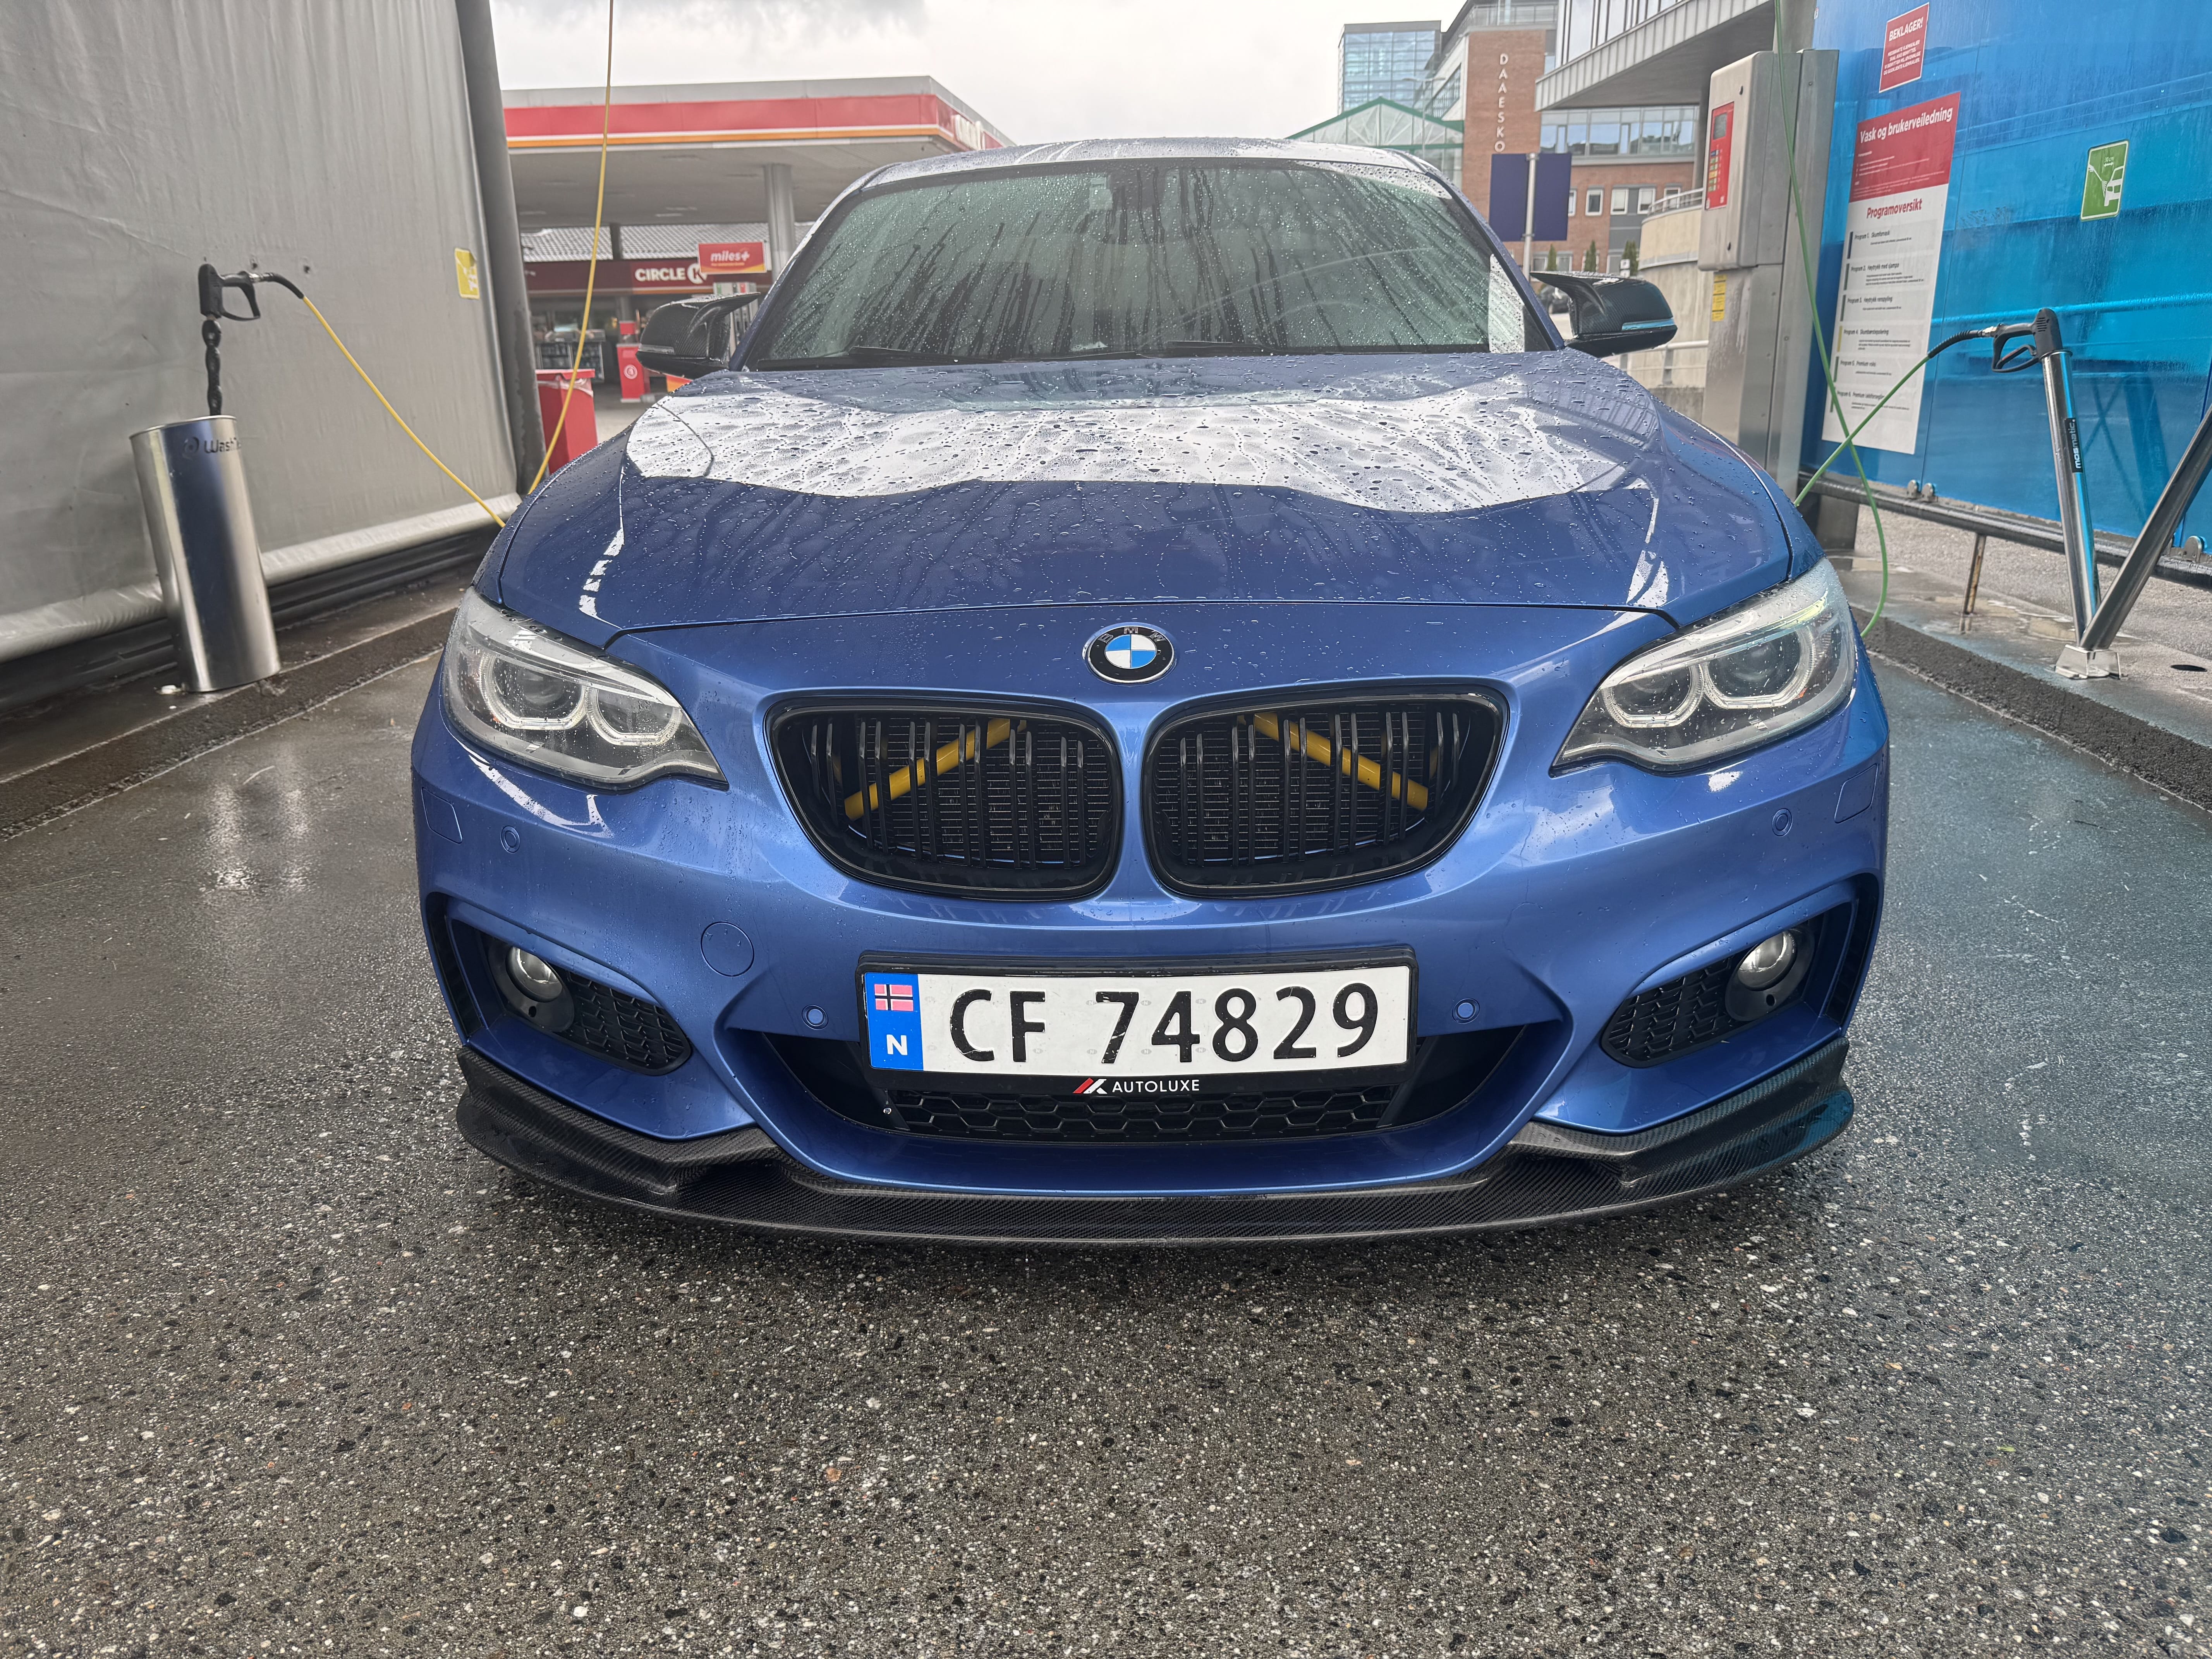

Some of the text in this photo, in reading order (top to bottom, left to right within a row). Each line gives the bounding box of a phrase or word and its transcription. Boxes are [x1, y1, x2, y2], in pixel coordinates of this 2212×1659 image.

[1889, 17, 1923, 42] BEKLAGER!
[1494, 53, 1509, 153] DAAESKO
[1860, 107, 1953, 143] Vask og brukerveiledning
[1866, 198, 1922, 219] Programoversikt
[635, 267, 686, 282] CIRCLE
[1098, 626, 1166, 644] BMW
[886, 982, 1378, 1064] N CF 74829
[1112, 1079, 1199, 1093] AUTOLUXE
